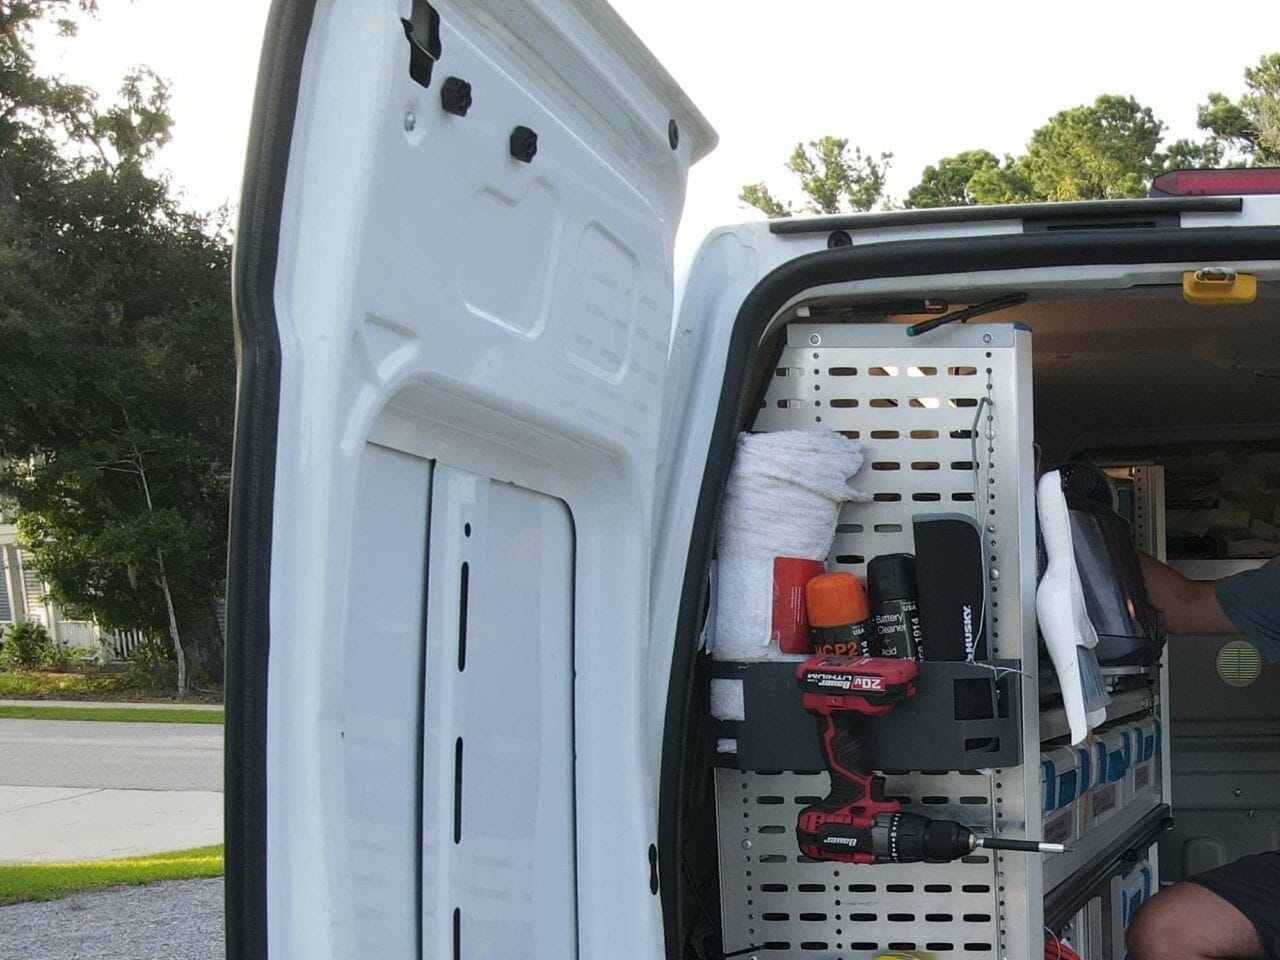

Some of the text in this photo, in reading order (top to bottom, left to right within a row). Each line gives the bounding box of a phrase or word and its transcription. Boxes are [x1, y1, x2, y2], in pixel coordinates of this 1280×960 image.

[903, 604, 917, 612] USA
[876, 613, 904, 625] Battery
[852, 627, 866, 637] USA
[877, 624, 907, 635] Cleaner
[963, 604, 974, 657] HUSKY
[807, 672, 853, 681] LITHIUM
[823, 836, 858, 847] Bauer
